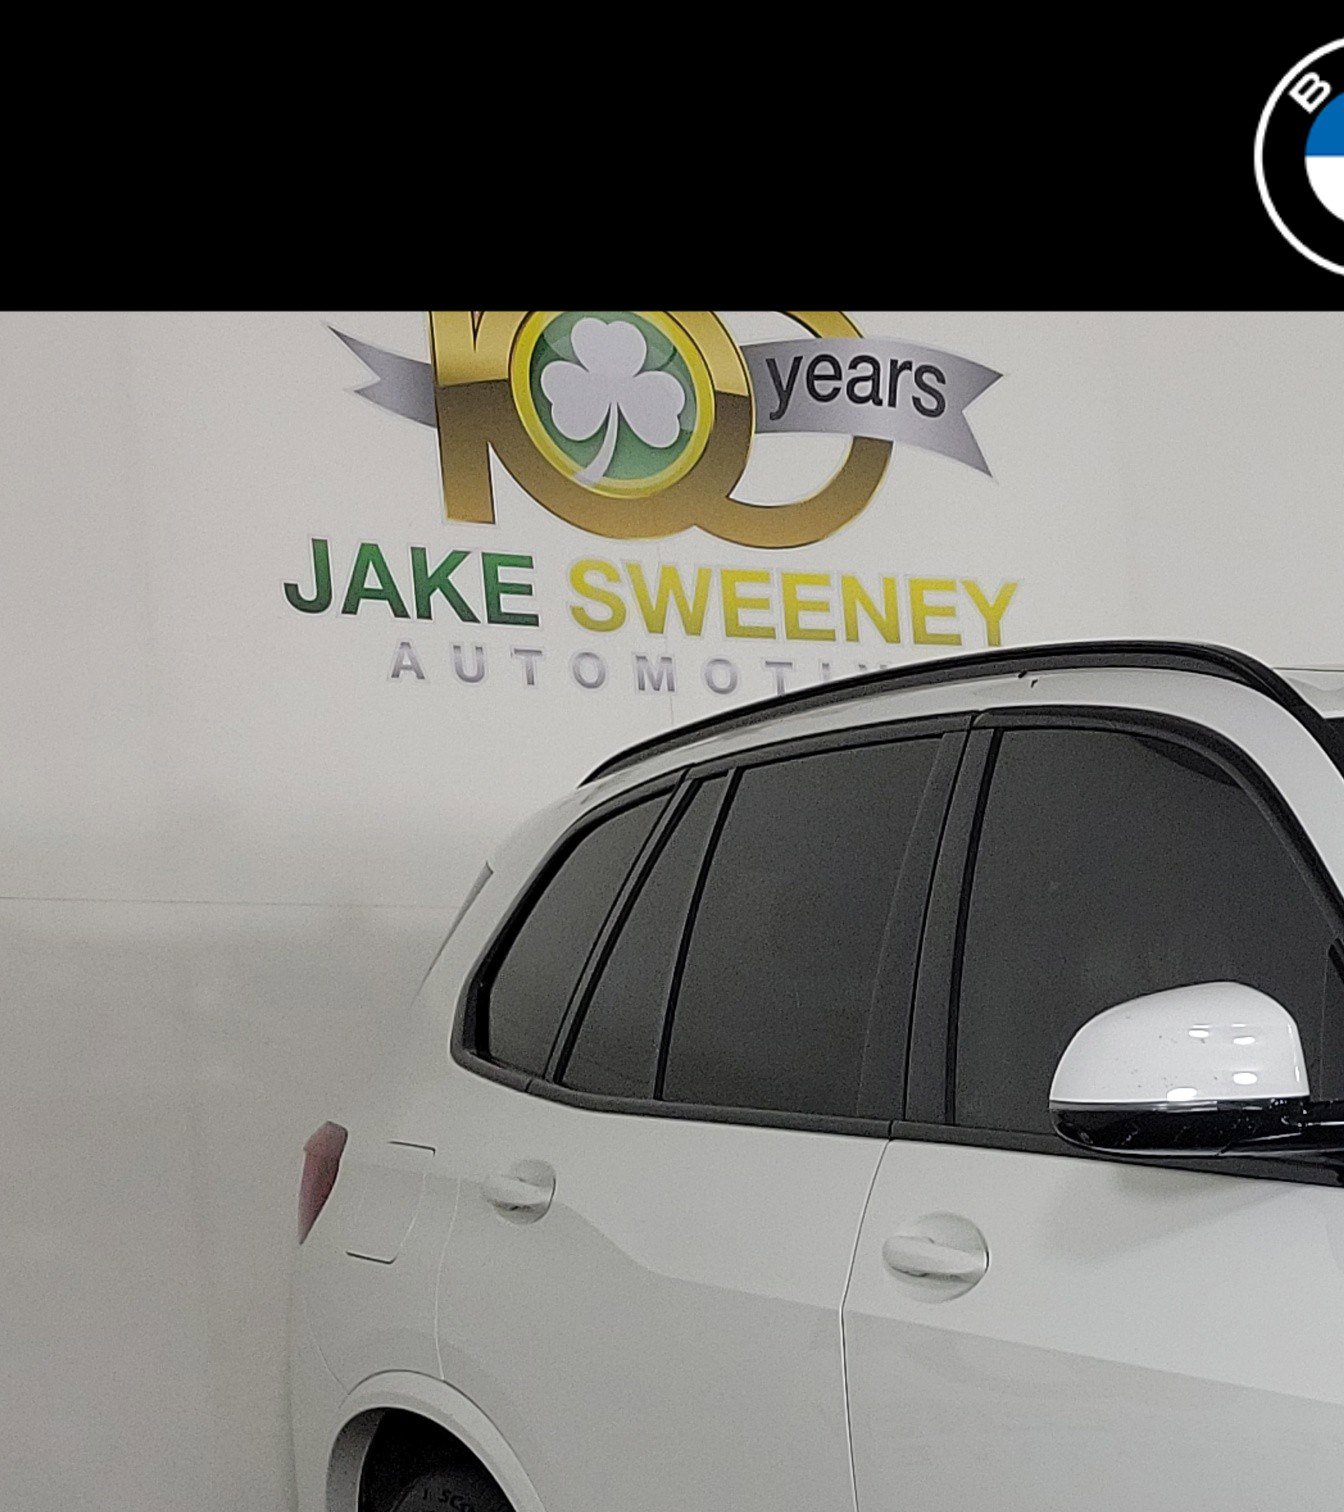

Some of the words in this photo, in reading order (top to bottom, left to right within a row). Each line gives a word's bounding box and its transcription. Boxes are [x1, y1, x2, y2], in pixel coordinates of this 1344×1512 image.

[766, 354, 946, 421] years
[285, 540, 538, 626] JAKE
[570, 560, 1017, 646] SWEENEY
[391, 641, 889, 694] AUTOMOTI
